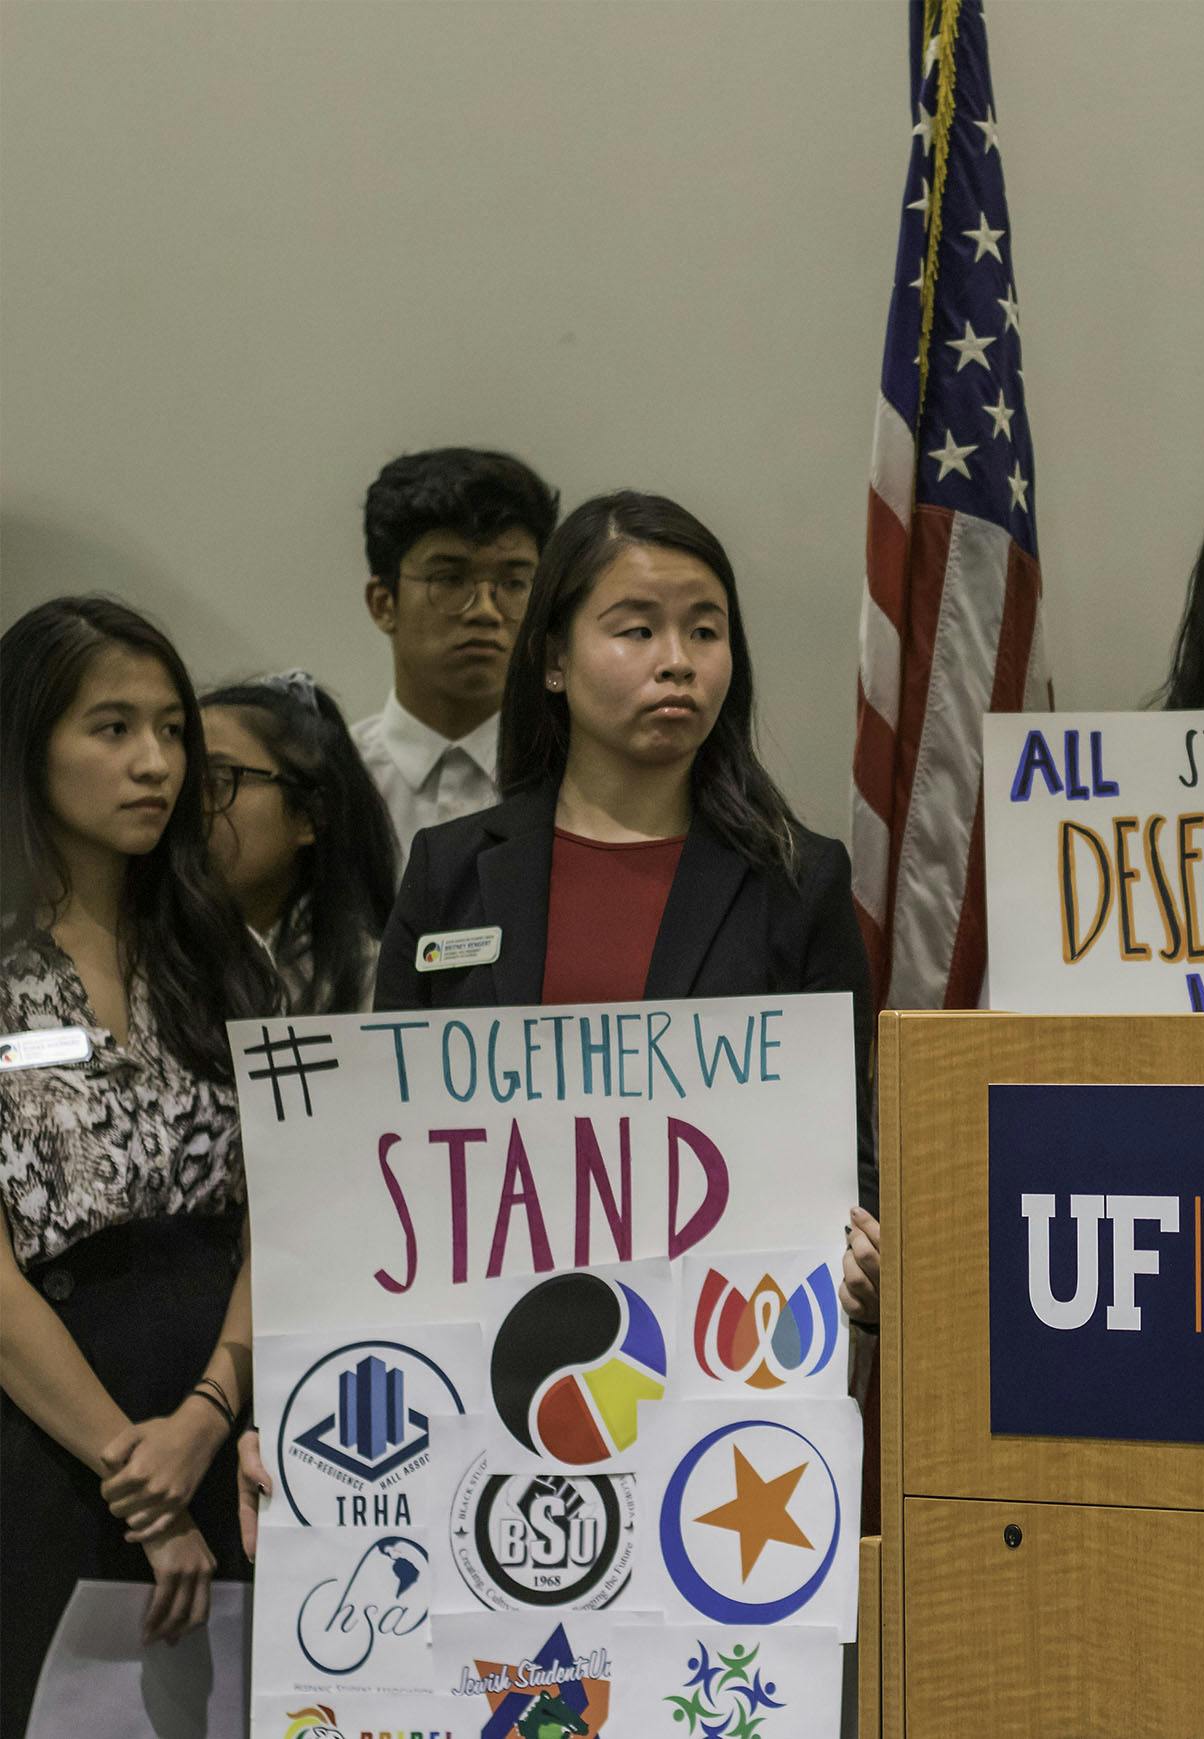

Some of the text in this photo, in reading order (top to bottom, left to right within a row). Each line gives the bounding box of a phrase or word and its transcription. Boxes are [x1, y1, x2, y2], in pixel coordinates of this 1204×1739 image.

[1010, 730, 1120, 802] ALL
[693, 1009, 784, 1090] WE
[373, 1116, 730, 1294] STAND
[1021, 1193, 1180, 1331] UF
[470, 1459, 488, 1486] STUD
[336, 1493, 412, 1527] IRHA
[499, 1495, 598, 1569] BSU
[533, 1575, 561, 1588] 1968
[452, 1666, 512, 1697] Jewish
[514, 1657, 590, 1689] Student
